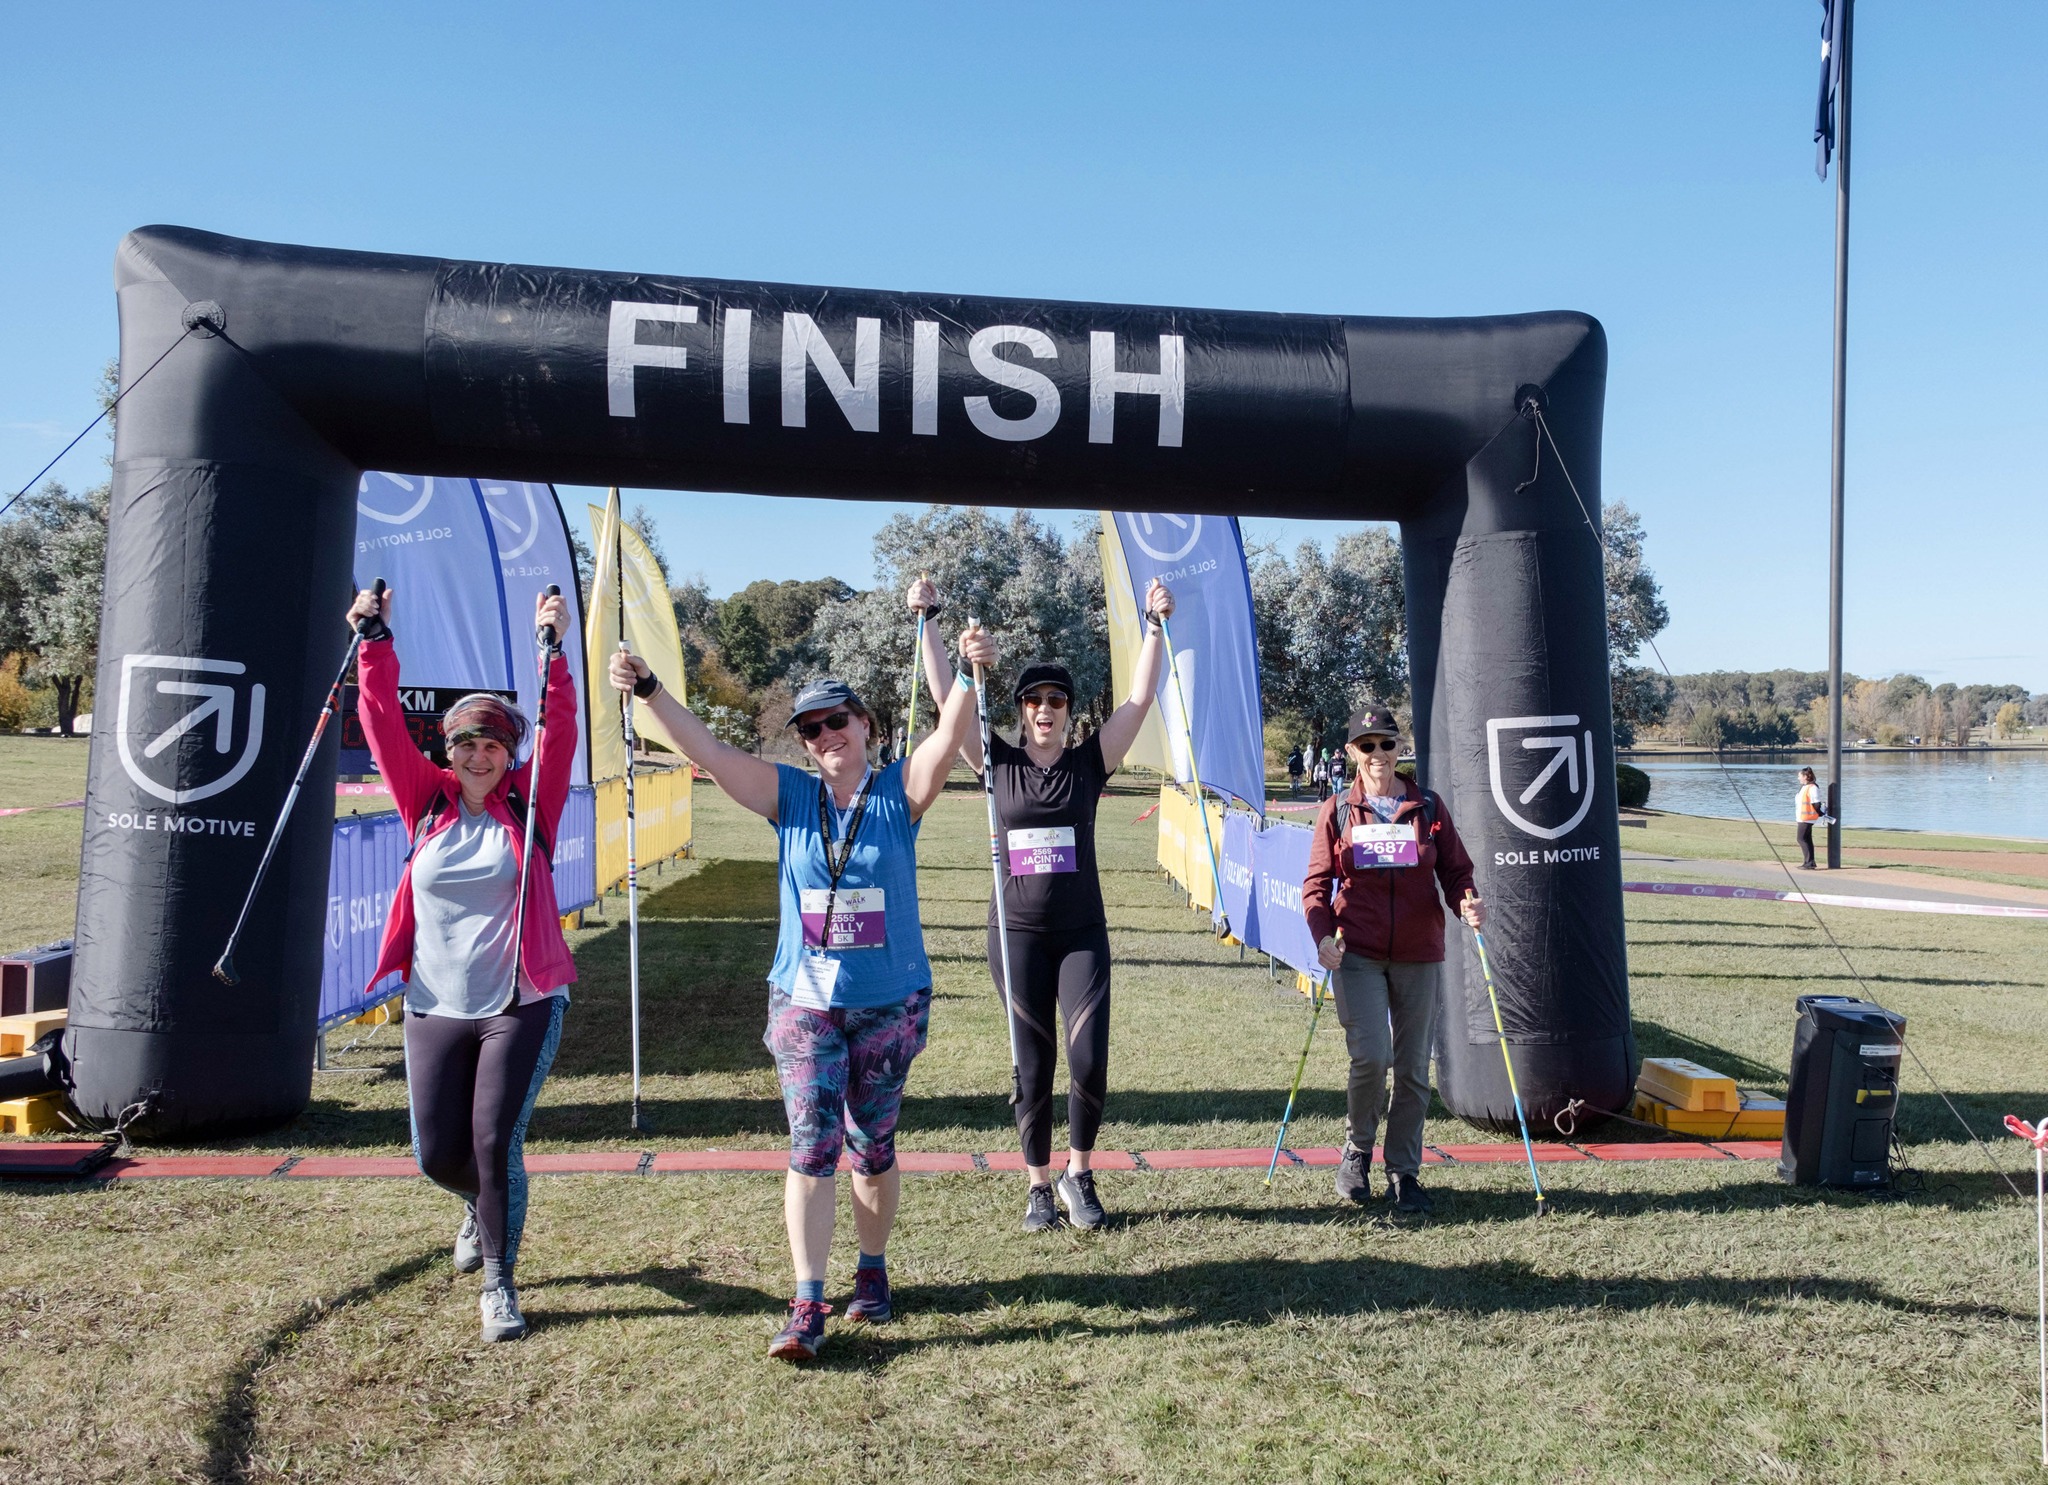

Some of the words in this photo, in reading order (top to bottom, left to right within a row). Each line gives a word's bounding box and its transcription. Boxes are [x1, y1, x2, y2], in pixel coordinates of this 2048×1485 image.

[607, 300, 1185, 448] FINISH
[398, 690, 435, 712] KM
[108, 812, 157, 831] SOLE
[164, 816, 256, 837] MOTIVE
[1044, 833, 1060, 842] WALK
[1032, 848, 1052, 856] 2569
[1362, 841, 1407, 855] 2687
[1021, 854, 1065, 866] JACINTA
[1494, 851, 1539, 866] SOLE
[1544, 846, 1600, 864] MOTIVE
[845, 896, 866, 906] WALK
[1271, 878, 1286, 908] SOLE
[1286, 883, 1305, 916] MOTI
[350, 892, 382, 934] SOLE
[831, 914, 855, 923] 2555
[823, 921, 864, 933] ALLY
